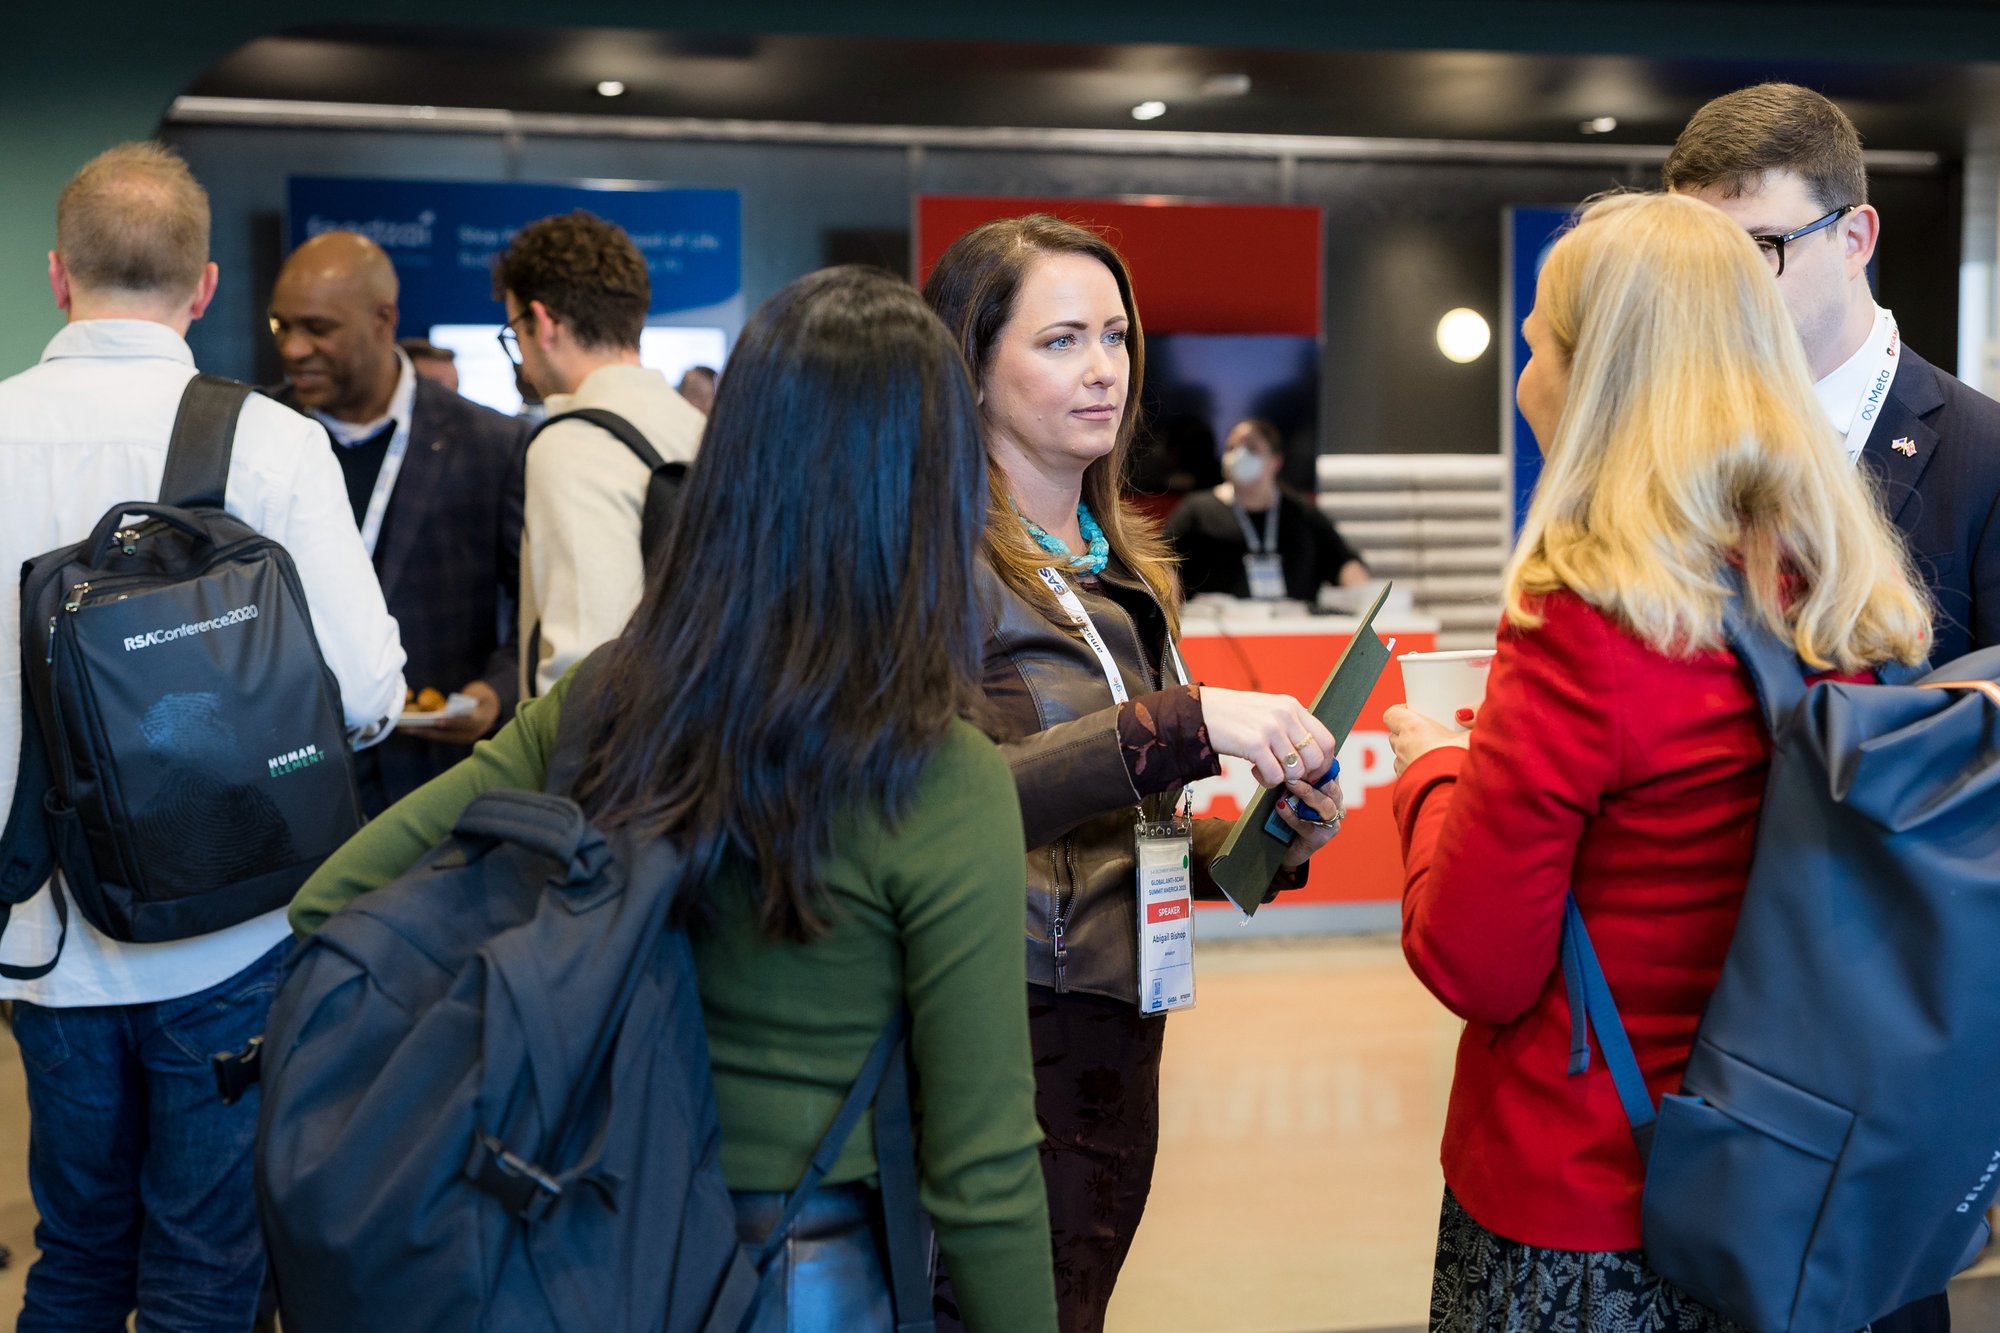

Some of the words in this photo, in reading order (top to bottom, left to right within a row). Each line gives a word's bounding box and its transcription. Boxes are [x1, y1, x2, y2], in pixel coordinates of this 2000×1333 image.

[1868, 369, 1890, 403] Meta
[1039, 568, 1065, 596] GAS
[1076, 616, 1103, 653] amazn
[268, 744, 316, 768] HUMAN
[269, 750, 324, 778] ELEMENT
[1158, 906, 1180, 916] SPEAKER
[1152, 933, 1169, 944] Abigail
[1170, 931, 1186, 941] Bishop
